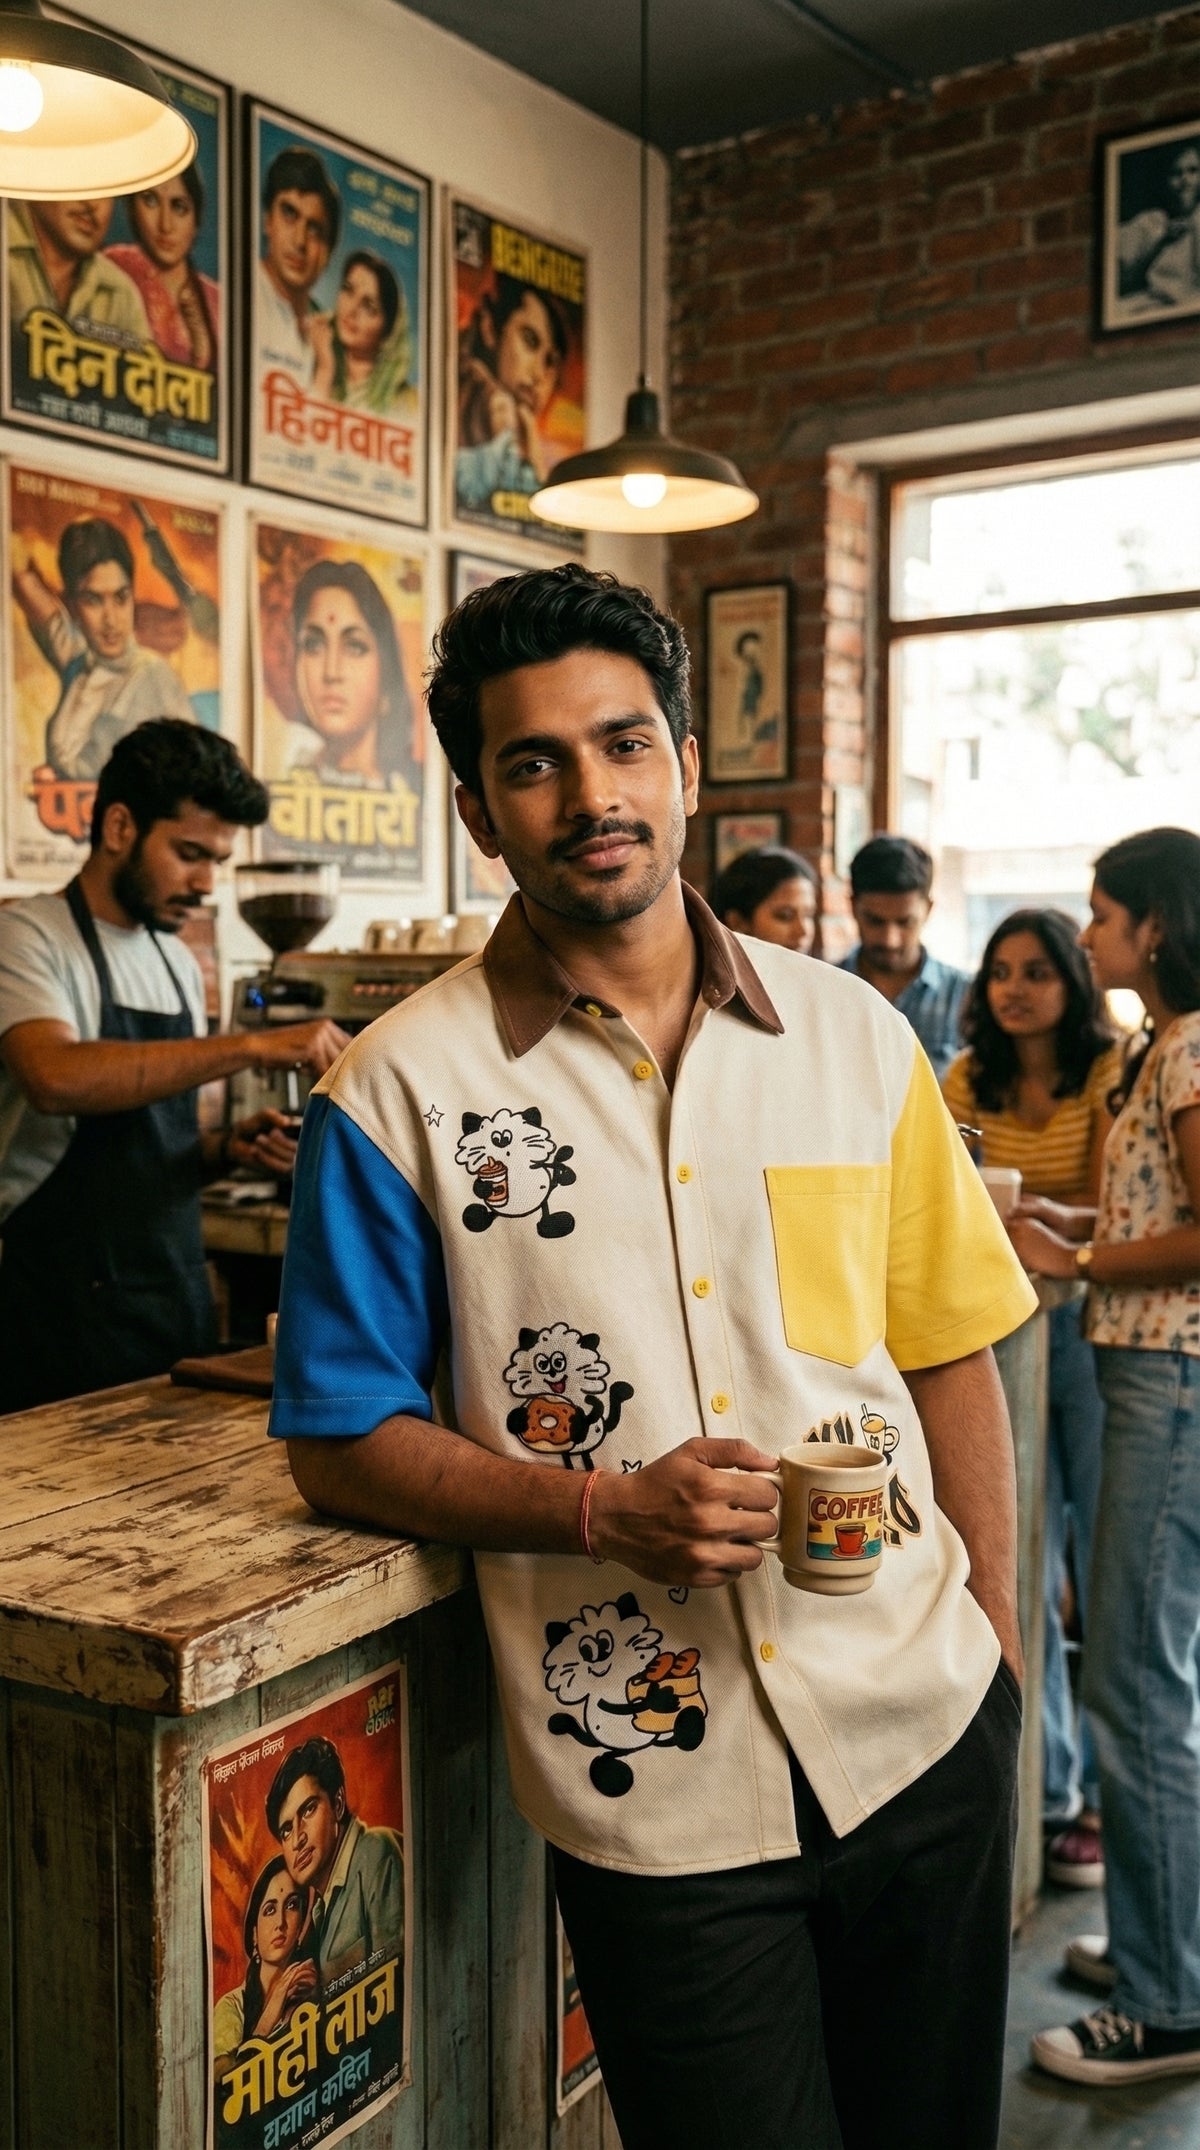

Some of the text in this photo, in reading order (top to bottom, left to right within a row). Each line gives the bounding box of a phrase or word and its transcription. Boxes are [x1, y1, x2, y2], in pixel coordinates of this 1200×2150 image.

[23, 309, 119, 398] दिन
[263, 371, 413, 478] हिनवाद
[811, 1492, 884, 1521] COFFEE
[222, 2002, 320, 2125] मोही
[325, 1957, 399, 2055] लाज
